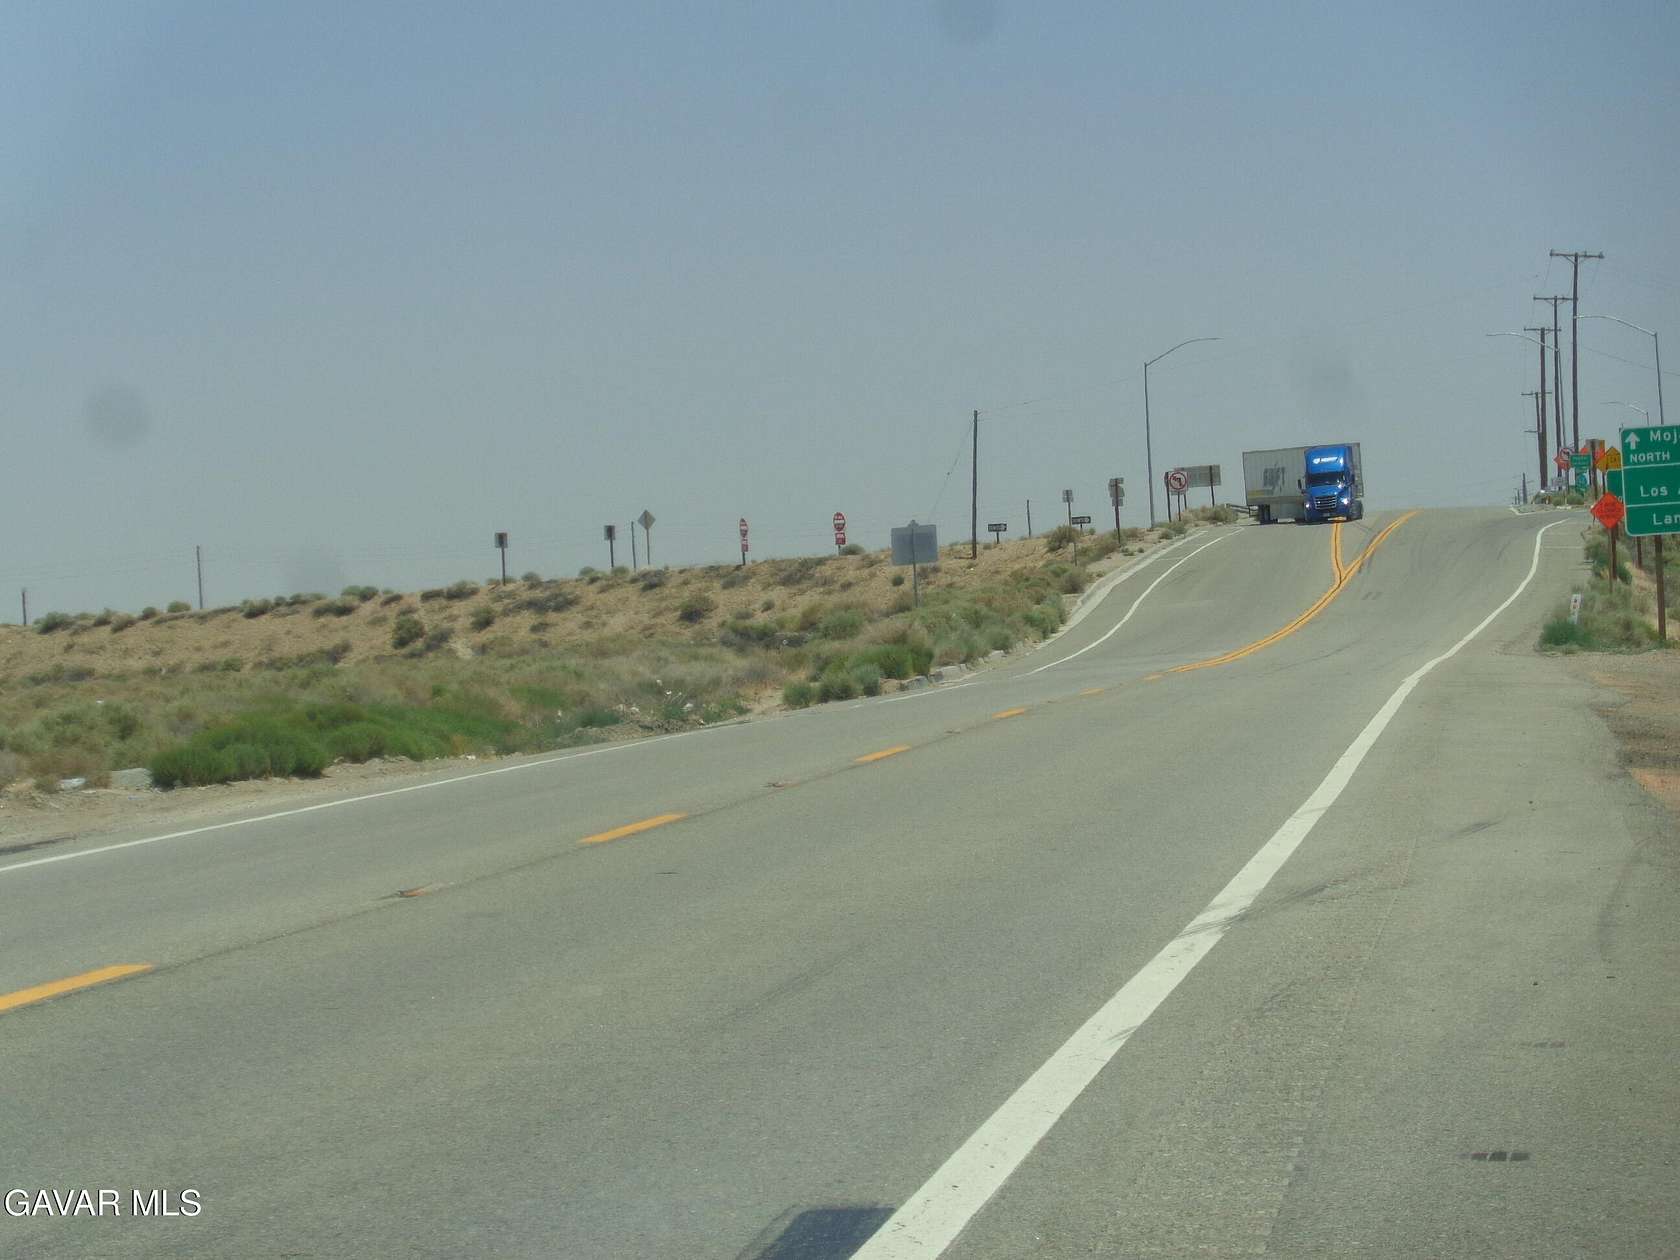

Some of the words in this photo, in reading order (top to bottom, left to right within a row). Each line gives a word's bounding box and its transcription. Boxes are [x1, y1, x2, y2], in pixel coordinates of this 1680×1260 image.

[1649, 429, 1680, 444] Moj
[1630, 451, 1670, 463] NORTH
[1640, 485, 1668, 497] Los
